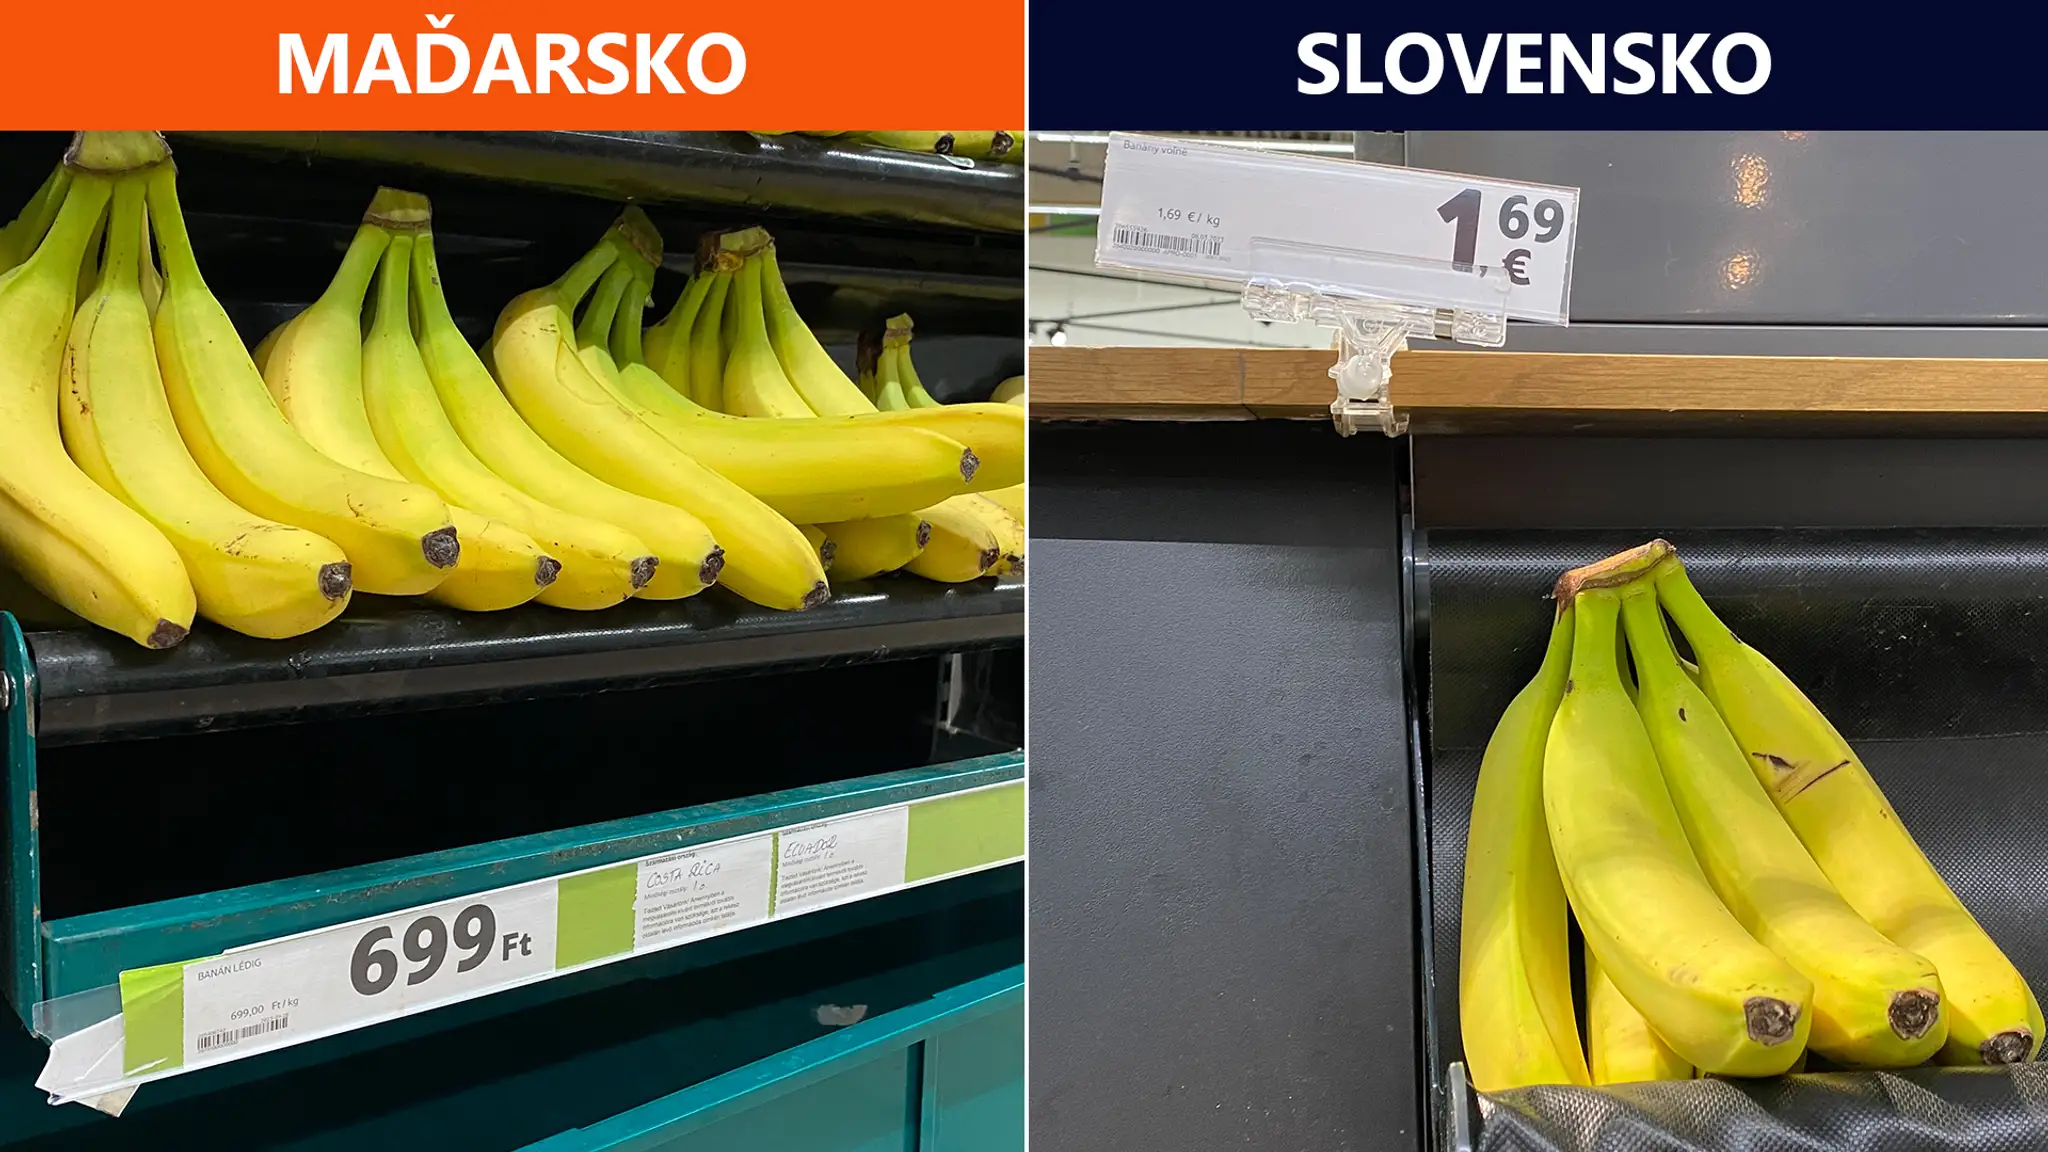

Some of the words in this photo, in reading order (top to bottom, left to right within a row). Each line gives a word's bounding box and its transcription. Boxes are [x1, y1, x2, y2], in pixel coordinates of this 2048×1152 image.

[1123, 140, 1160, 155] Banány
[1158, 208, 1181, 221] 1,69
[1207, 213, 1220, 228] kg
[1498, 194, 1564, 244] 69
[1502, 248, 1531, 286] €
[783, 834, 838, 859] ECUADOR
[646, 867, 683, 889] COSTA
[350, 903, 496, 996] 699
[502, 932, 532, 961] Ft
[197, 965, 231, 981] BANÁN
[233, 958, 262, 972] LÉDIG
[230, 1004, 264, 1021] 699,00
